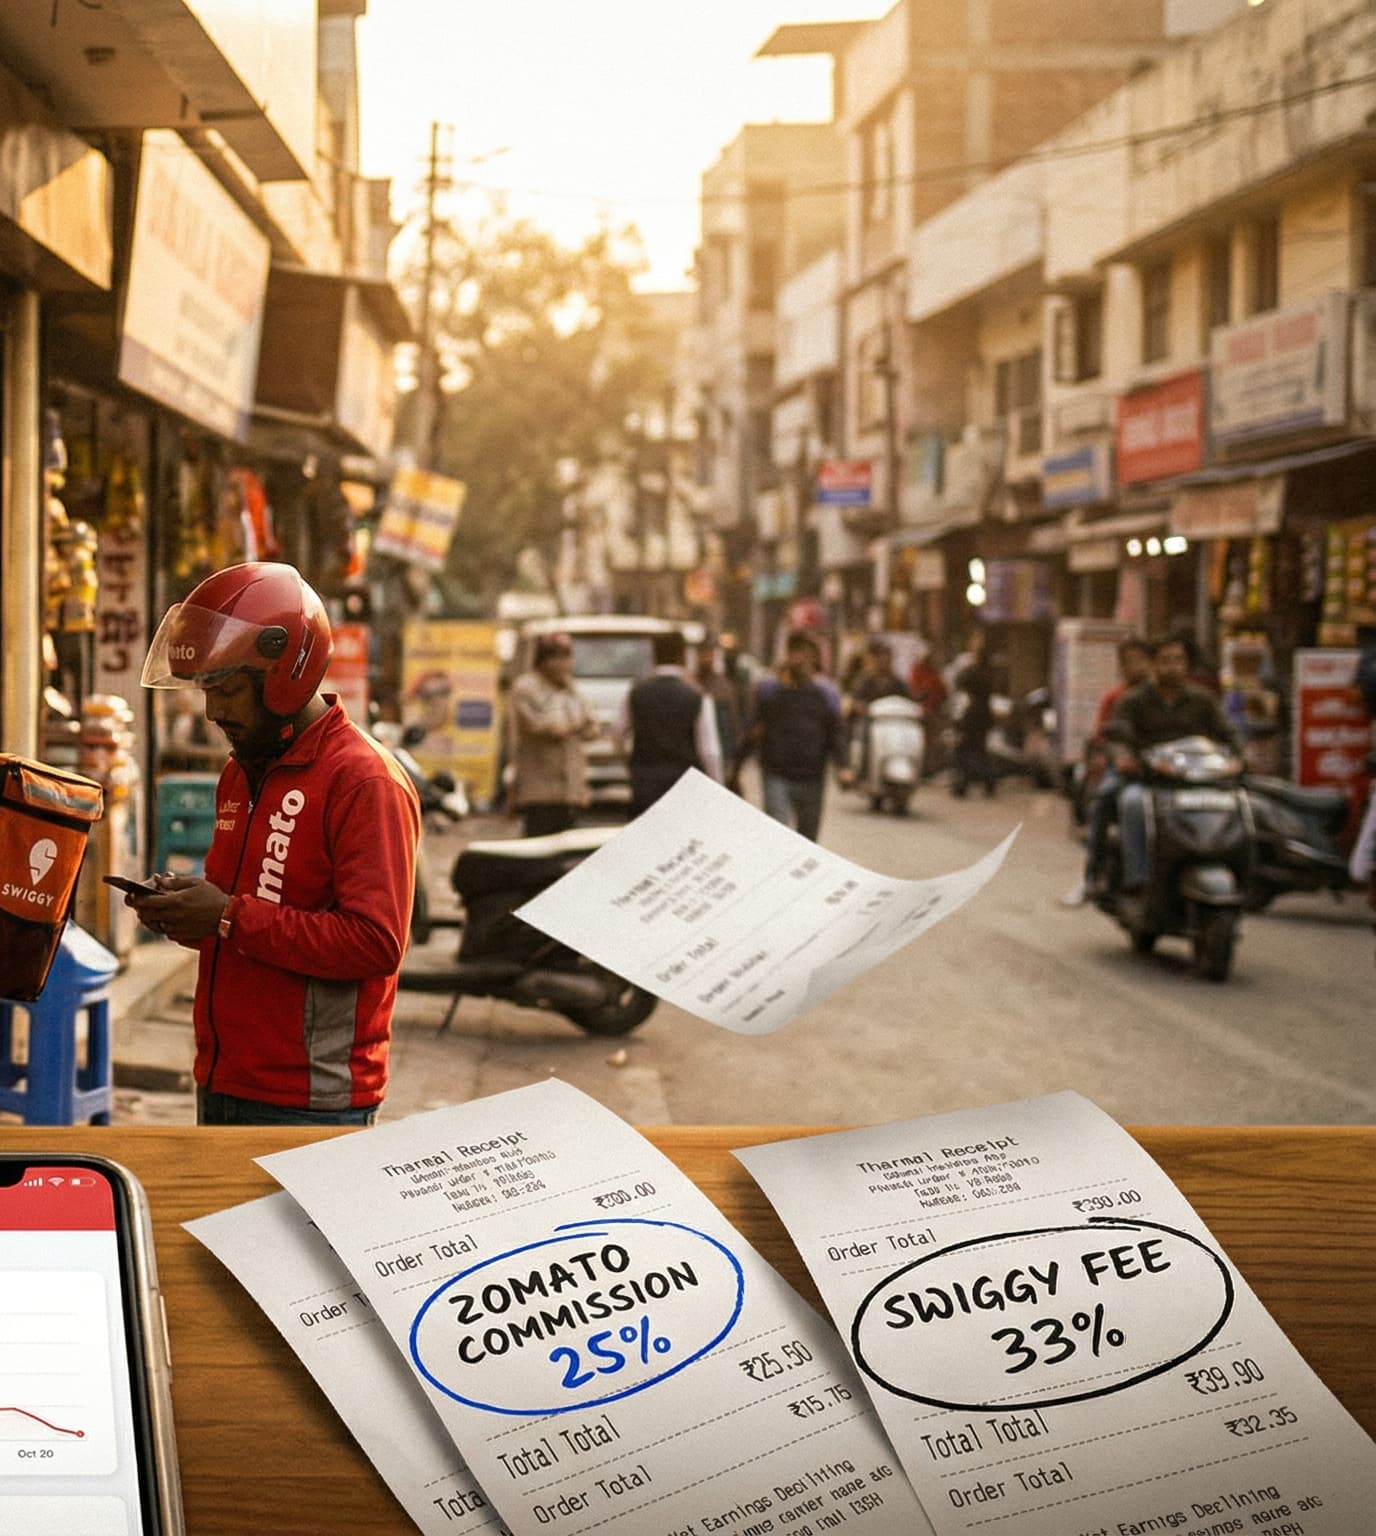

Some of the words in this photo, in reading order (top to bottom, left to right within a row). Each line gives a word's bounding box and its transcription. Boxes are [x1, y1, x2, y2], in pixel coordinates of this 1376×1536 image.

[1, 884, 55, 907] SWIGGY
[374, 1252, 425, 1277] Order
[429, 1234, 479, 1261] Total
[827, 1240, 878, 1261] Order
[885, 1227, 937, 1251] Total
[449, 1244, 631, 1325] ZOMATO
[883, 1261, 1059, 1329] SWIGGY
[1081, 1238, 1172, 1286] FEE
[299, 1302, 348, 1327] Order
[458, 1261, 699, 1365] COMMISSION
[549, 1316, 672, 1390] 25%
[739, 1340, 814, 1382] ₹25.50
[991, 1304, 1126, 1374] 33%
[1184, 1357, 1265, 1396] ₹39.90
[921, 1423, 983, 1461] Total
[986, 1409, 1050, 1445] Total
[1223, 1406, 1299, 1438] ₹32.35
[18, 1449, 36, 1458] Oct
[40, 1449, 54, 1458] 20
[497, 1442, 560, 1480] Total
[560, 1415, 622, 1456] Total
[433, 1490, 486, 1520] Tota
[533, 1490, 591, 1525] Order
[596, 1465, 654, 1504] Total
[948, 1480, 1007, 1508] Order
[1013, 1461, 1074, 1492] Total
